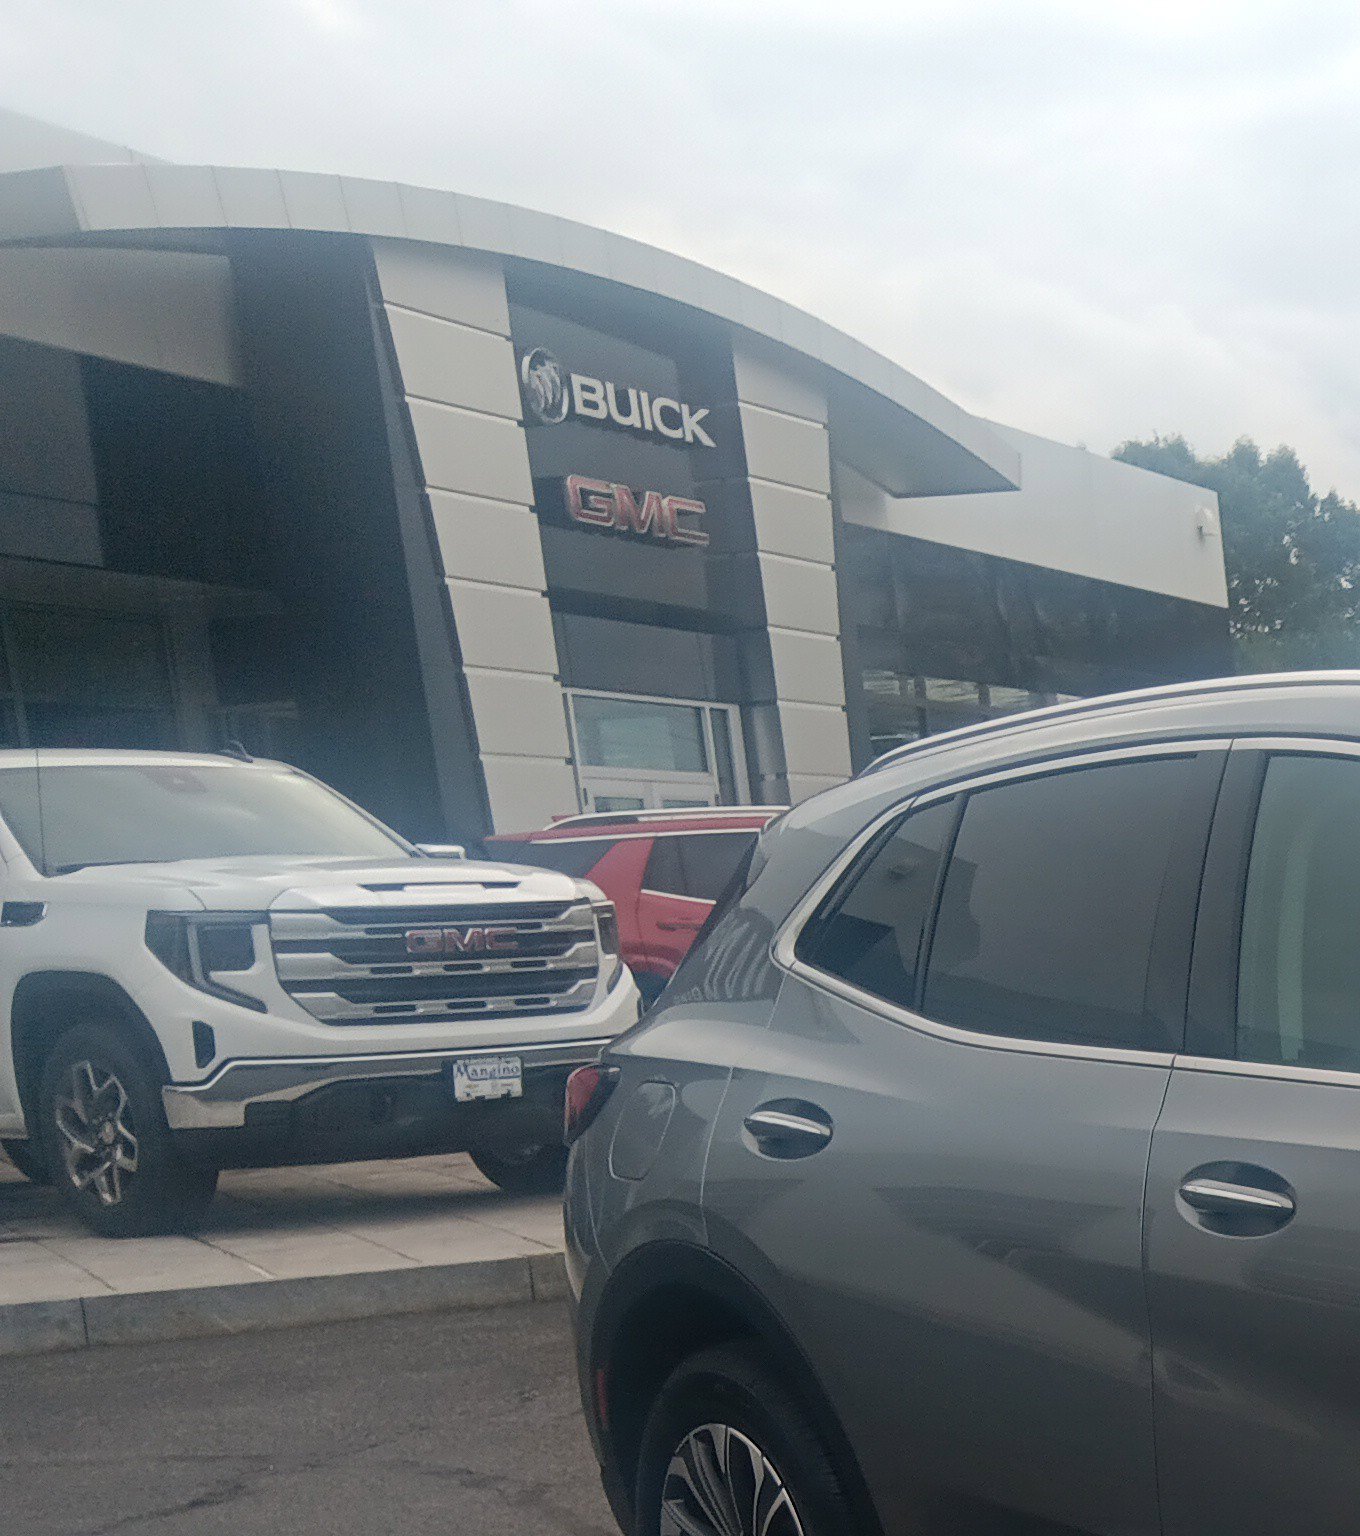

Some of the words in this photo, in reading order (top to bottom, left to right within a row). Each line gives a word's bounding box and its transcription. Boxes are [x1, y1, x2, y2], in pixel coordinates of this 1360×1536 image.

[570, 372, 718, 448] BUICK
[566, 474, 710, 547] GMC
[404, 926, 519, 953] GMC
